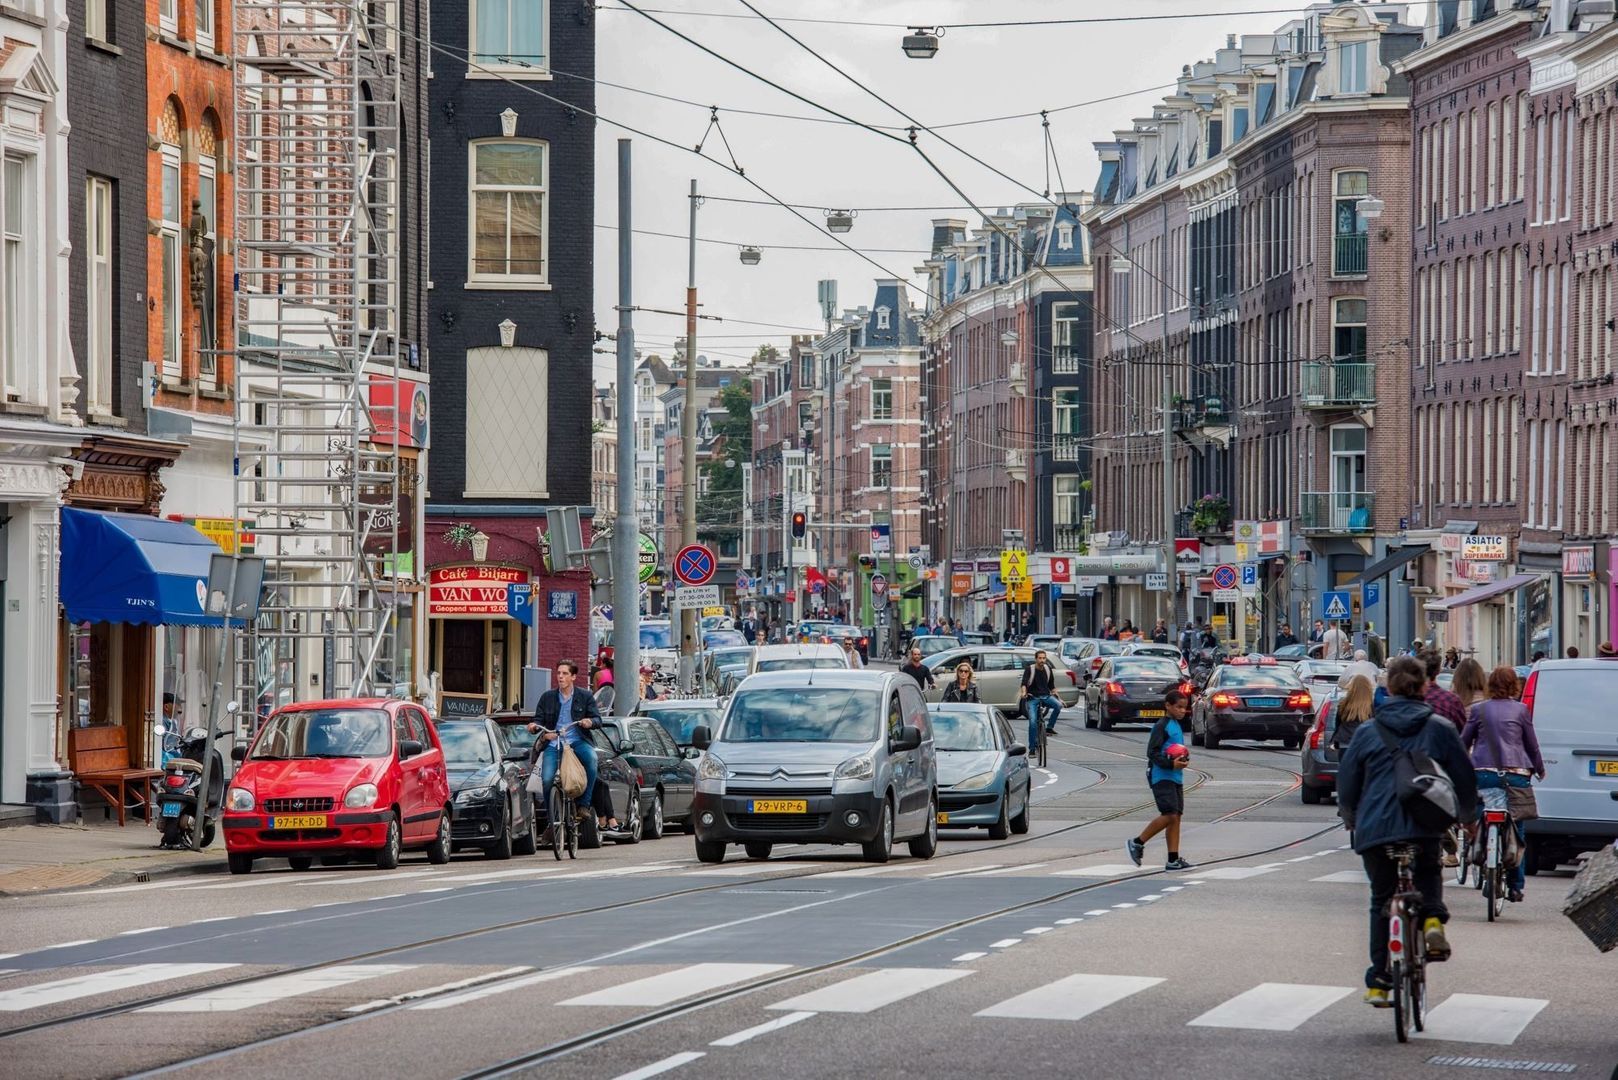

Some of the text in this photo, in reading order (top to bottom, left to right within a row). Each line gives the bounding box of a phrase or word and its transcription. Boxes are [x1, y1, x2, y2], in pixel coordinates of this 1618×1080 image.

[1465, 536, 1502, 545] ASIATIC
[439, 567, 520, 582] Café Biljart
[1245, 567, 1253, 576] P
[440, 588, 509, 601] VAN WO
[1368, 590, 1375, 600] P
[126, 597, 156, 607] TJIN'S
[514, 595, 525, 612] P
[435, 605, 467, 613] Geopend
[756, 801, 803, 812] 29-VRP-6
[277, 816, 324, 827] 97-FK-DD
